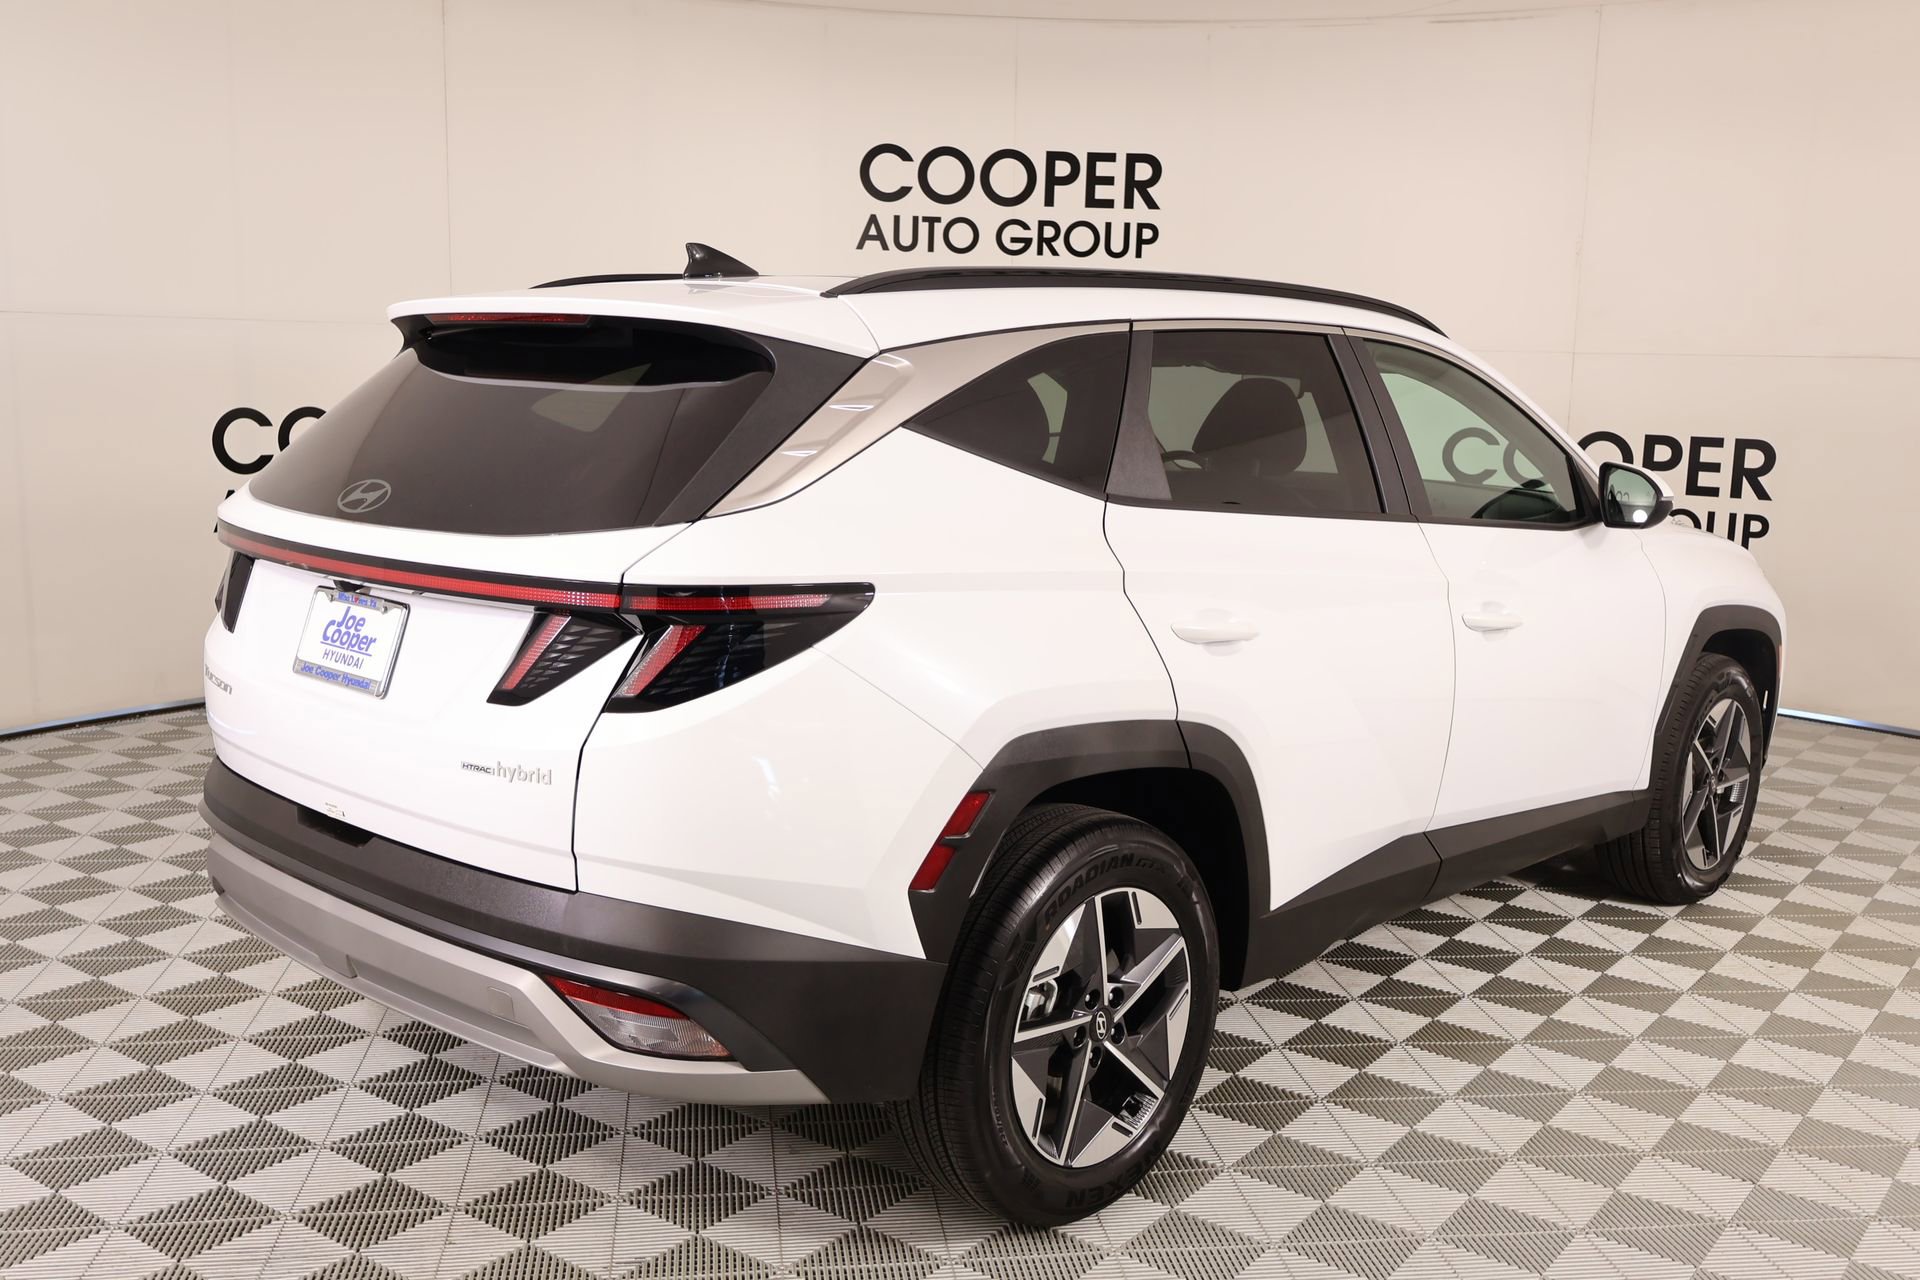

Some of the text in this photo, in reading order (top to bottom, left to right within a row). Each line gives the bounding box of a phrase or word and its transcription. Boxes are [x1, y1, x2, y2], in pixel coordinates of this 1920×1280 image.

[859, 143, 1163, 210] COOPER
[856, 213, 1160, 259] AUTO GROUP
[336, 606, 366, 632] Joe
[322, 619, 377, 652] Cooper
[322, 648, 365, 670] HYUNDAI
[300, 661, 371, 690] Joe Cooper Hyundai
[461, 760, 553, 785] HTRAC hybrid
[1044, 853, 1135, 921] ROADIAN
